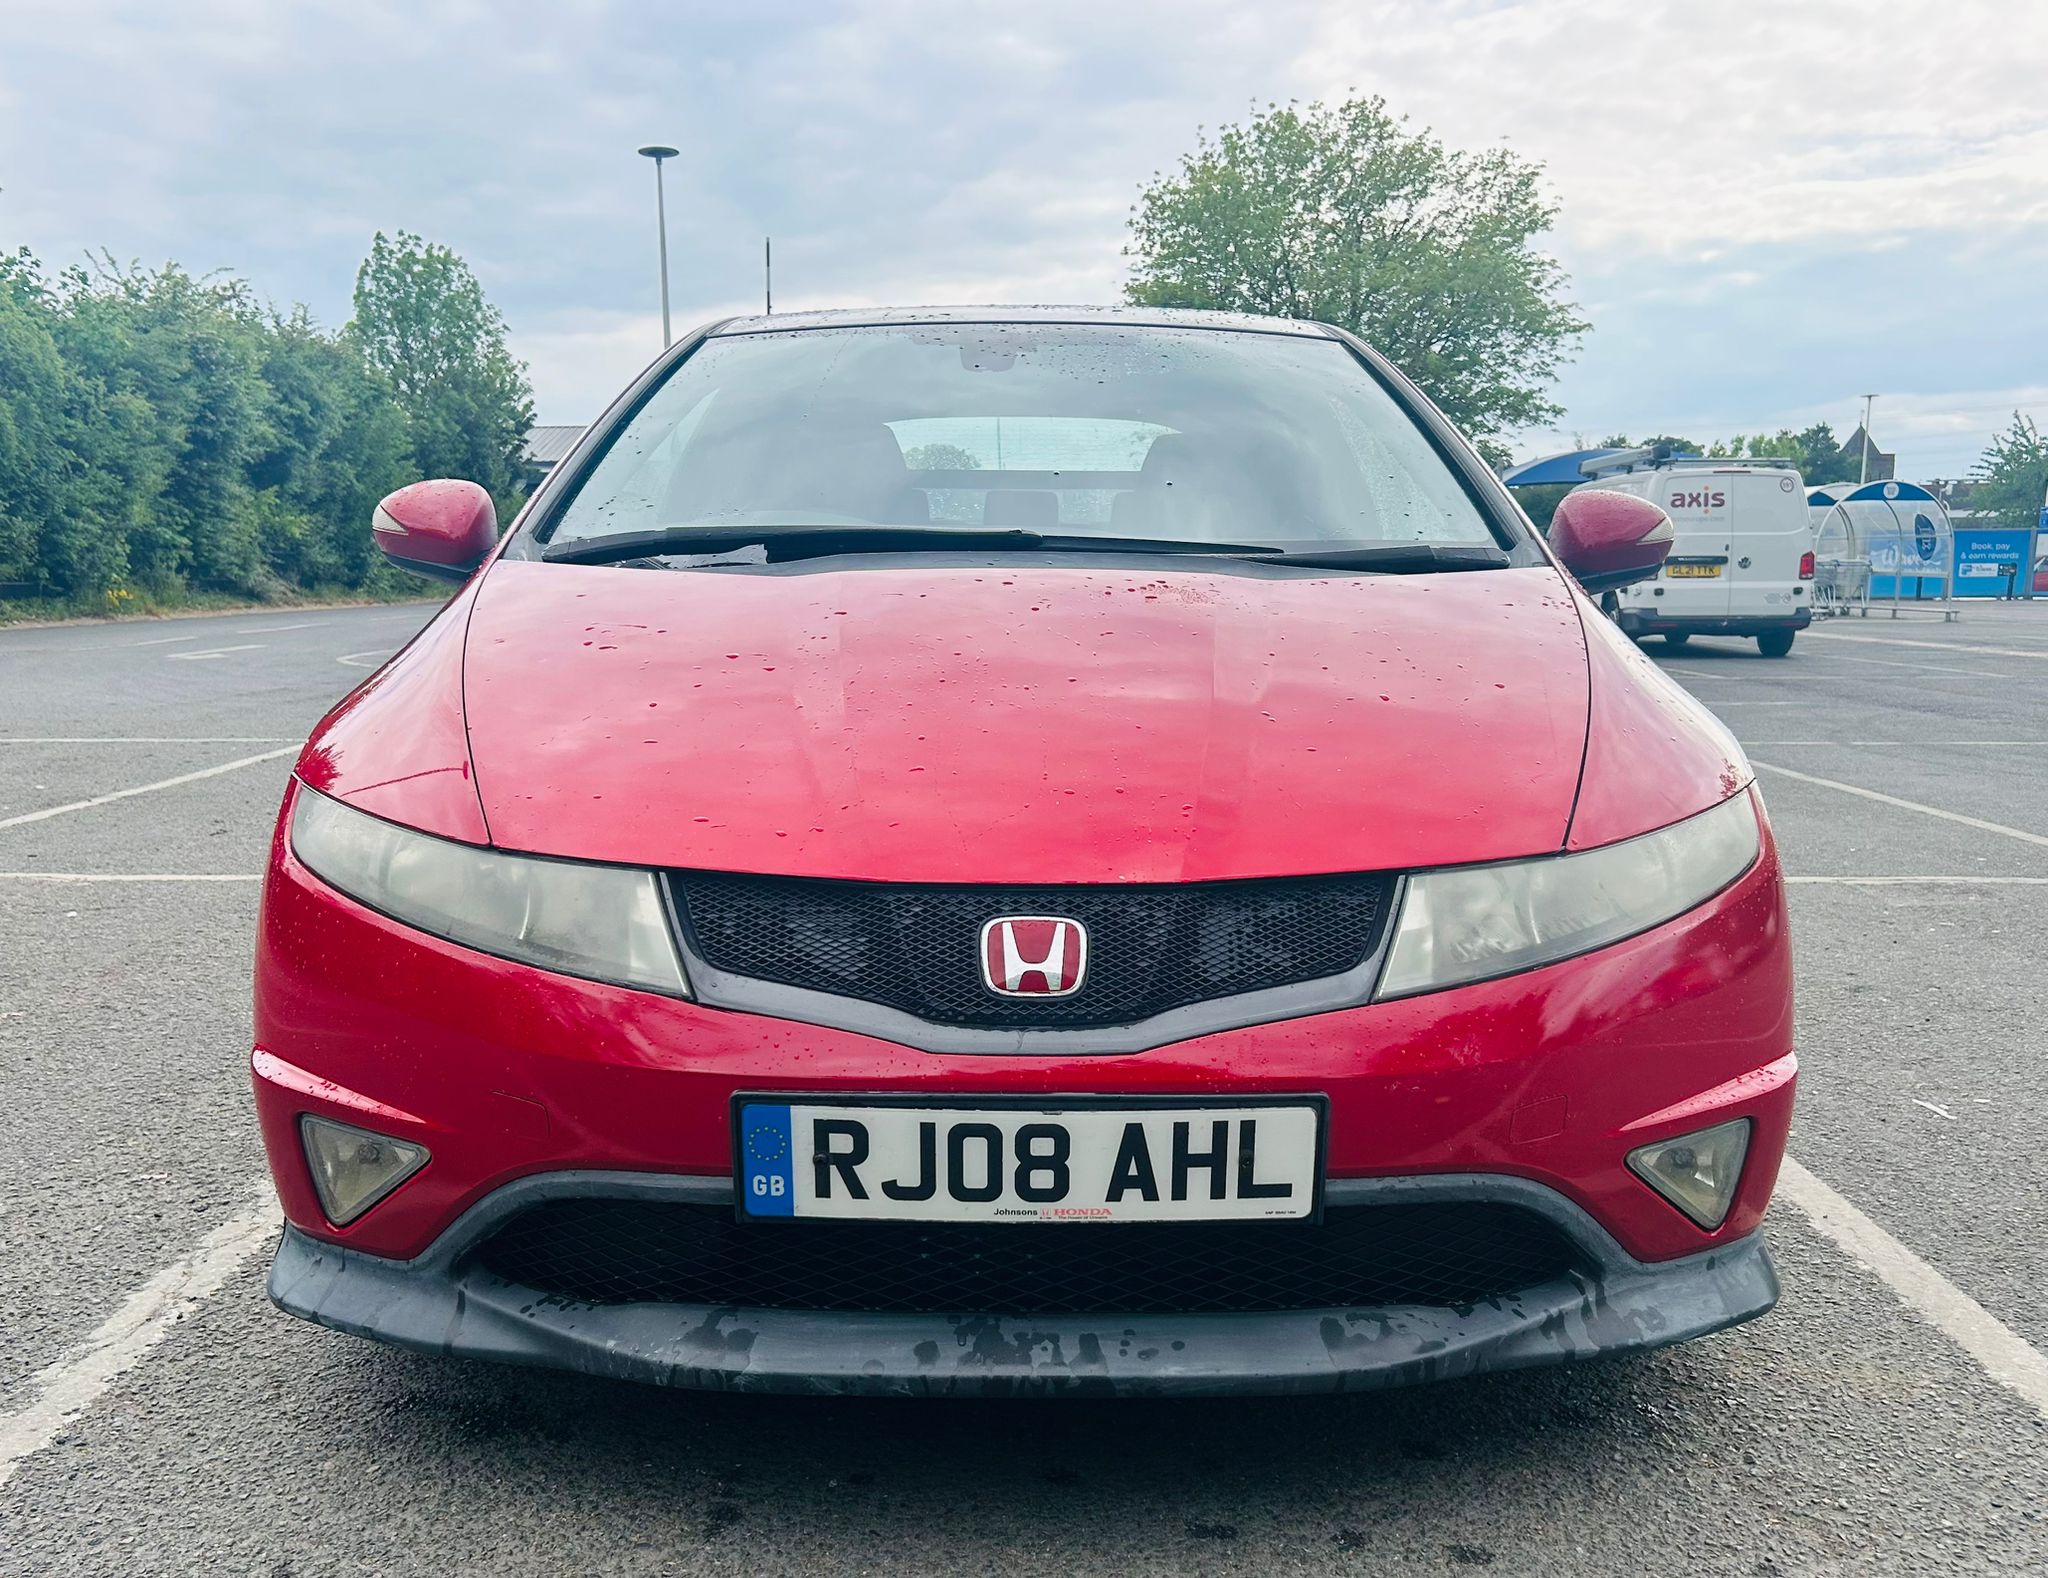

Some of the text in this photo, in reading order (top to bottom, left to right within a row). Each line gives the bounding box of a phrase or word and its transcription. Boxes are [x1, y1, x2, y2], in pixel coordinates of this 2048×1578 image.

[1670, 486, 1726, 511] axis
[1995, 543, 2010, 551] pay
[813, 1118, 1293, 1203] RJ08 AHL
[752, 1174, 785, 1197] GB
[993, 1208, 1112, 1216] Johnsons HONDA
